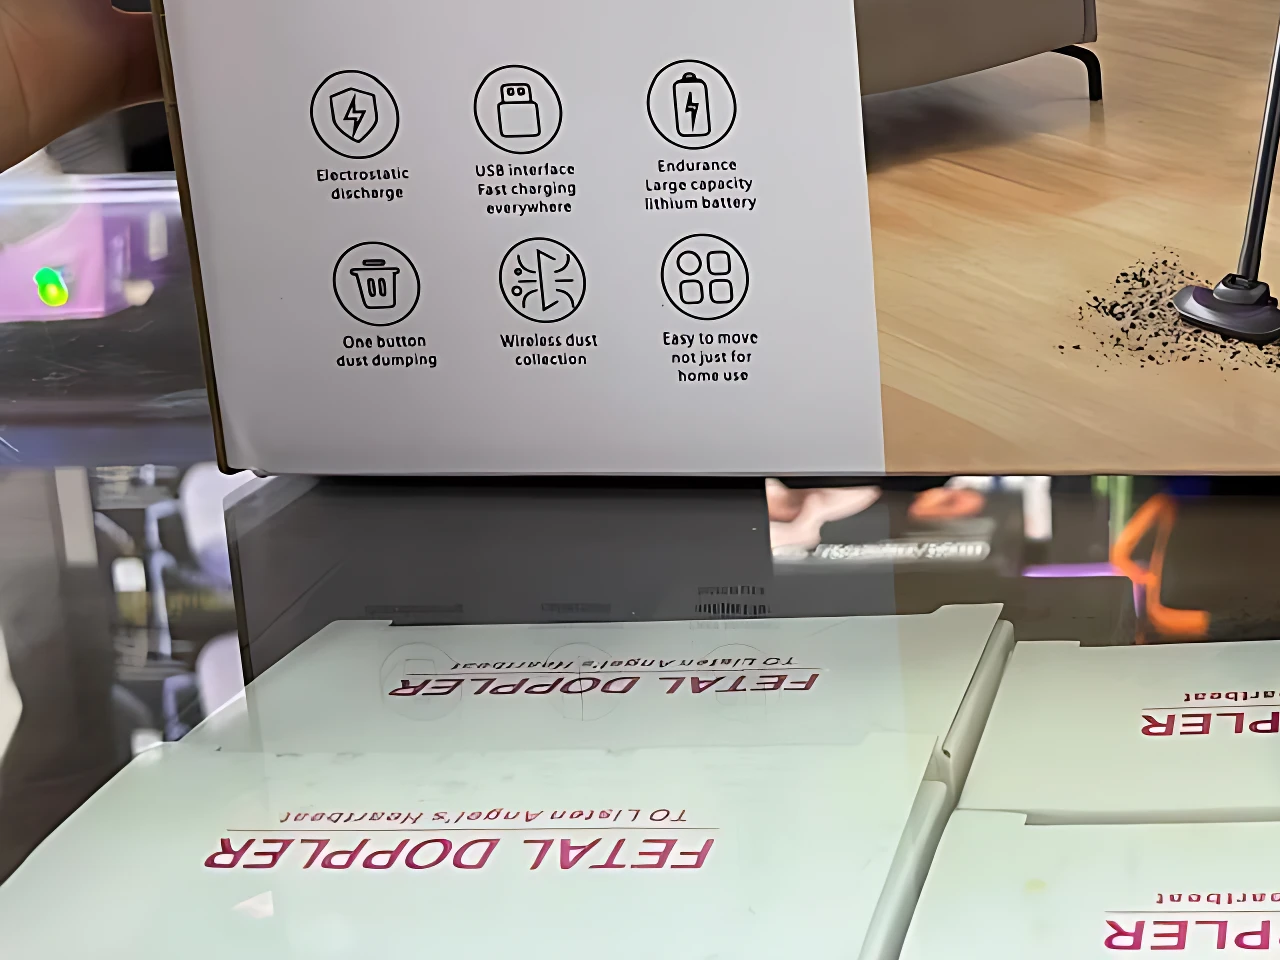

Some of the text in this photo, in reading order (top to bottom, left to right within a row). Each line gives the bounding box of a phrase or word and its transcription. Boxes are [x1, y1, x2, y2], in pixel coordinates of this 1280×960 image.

[316, 166, 409, 182] Electrostatic
[475, 162, 575, 177] USB interface
[657, 159, 737, 173] Endurance
[477, 181, 576, 198] Fast charging
[645, 176, 753, 195] Large capacity
[331, 186, 404, 202] discharge
[486, 200, 572, 217] everywhere
[644, 195, 757, 211] lithium battery
[342, 335, 427, 349] One button
[499, 332, 598, 348] Wireless dust
[662, 331, 758, 349] Easy to move
[336, 352, 437, 369] dust dumping
[515, 352, 587, 366] collection
[671, 349, 752, 367] not just for
[677, 369, 749, 382] home use
[388, 673, 821, 697] FETAL DOPPLER
[648, 808, 689, 823] TO
[203, 837, 716, 871] FETAL DOPPLER
